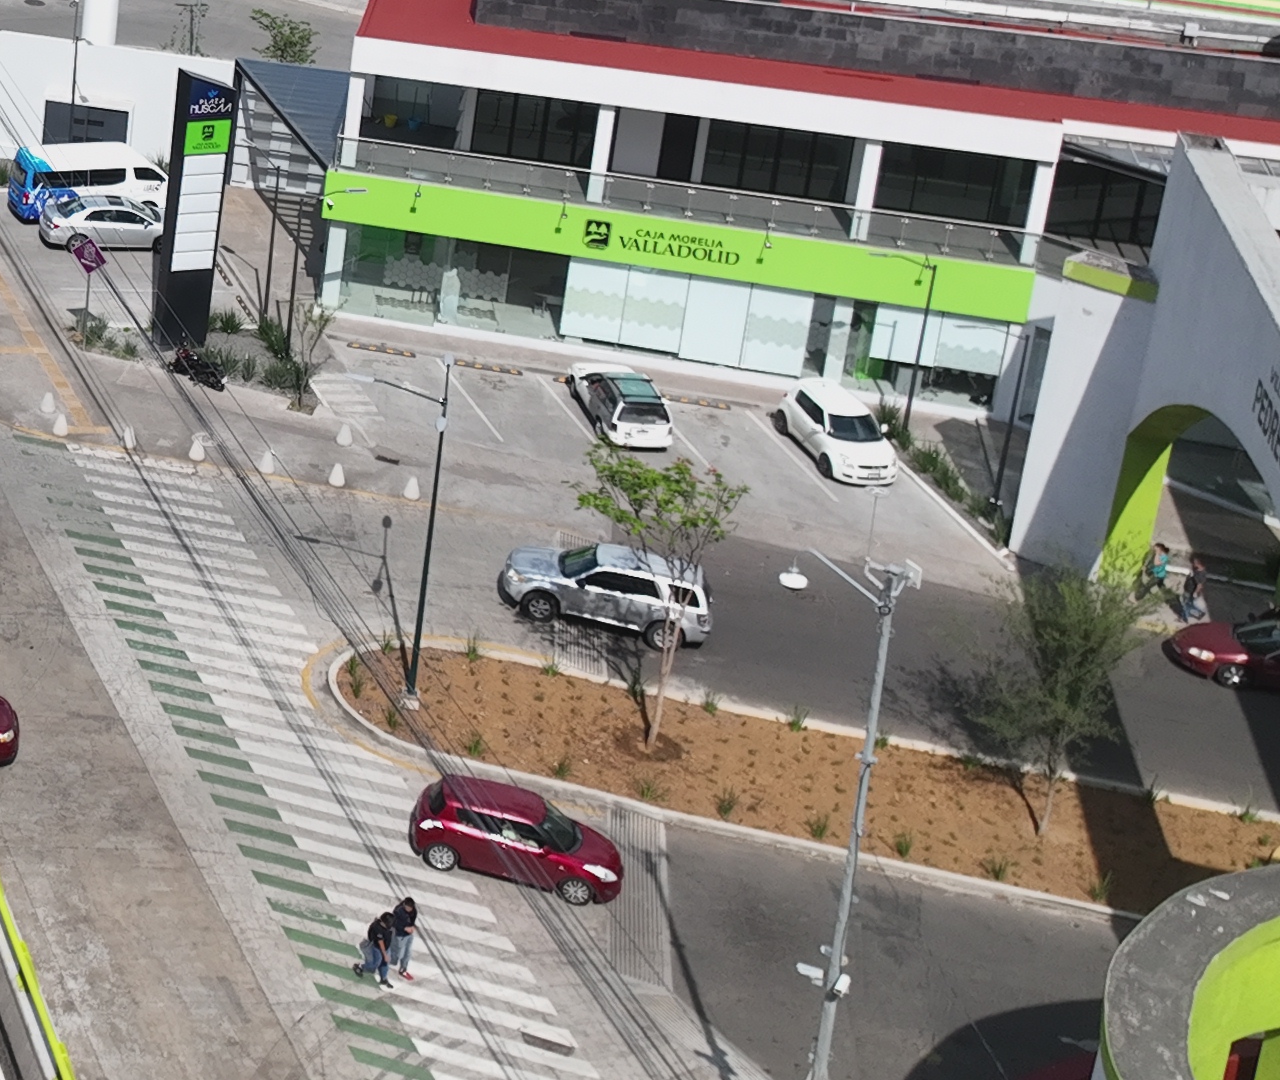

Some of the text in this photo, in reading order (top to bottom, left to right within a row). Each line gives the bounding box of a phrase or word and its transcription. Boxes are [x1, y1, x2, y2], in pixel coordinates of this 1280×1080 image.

[199, 97, 226, 105] PLAZA
[635, 228, 724, 249] CAJA MORELIA
[618, 235, 741, 266] VALLADOLID
